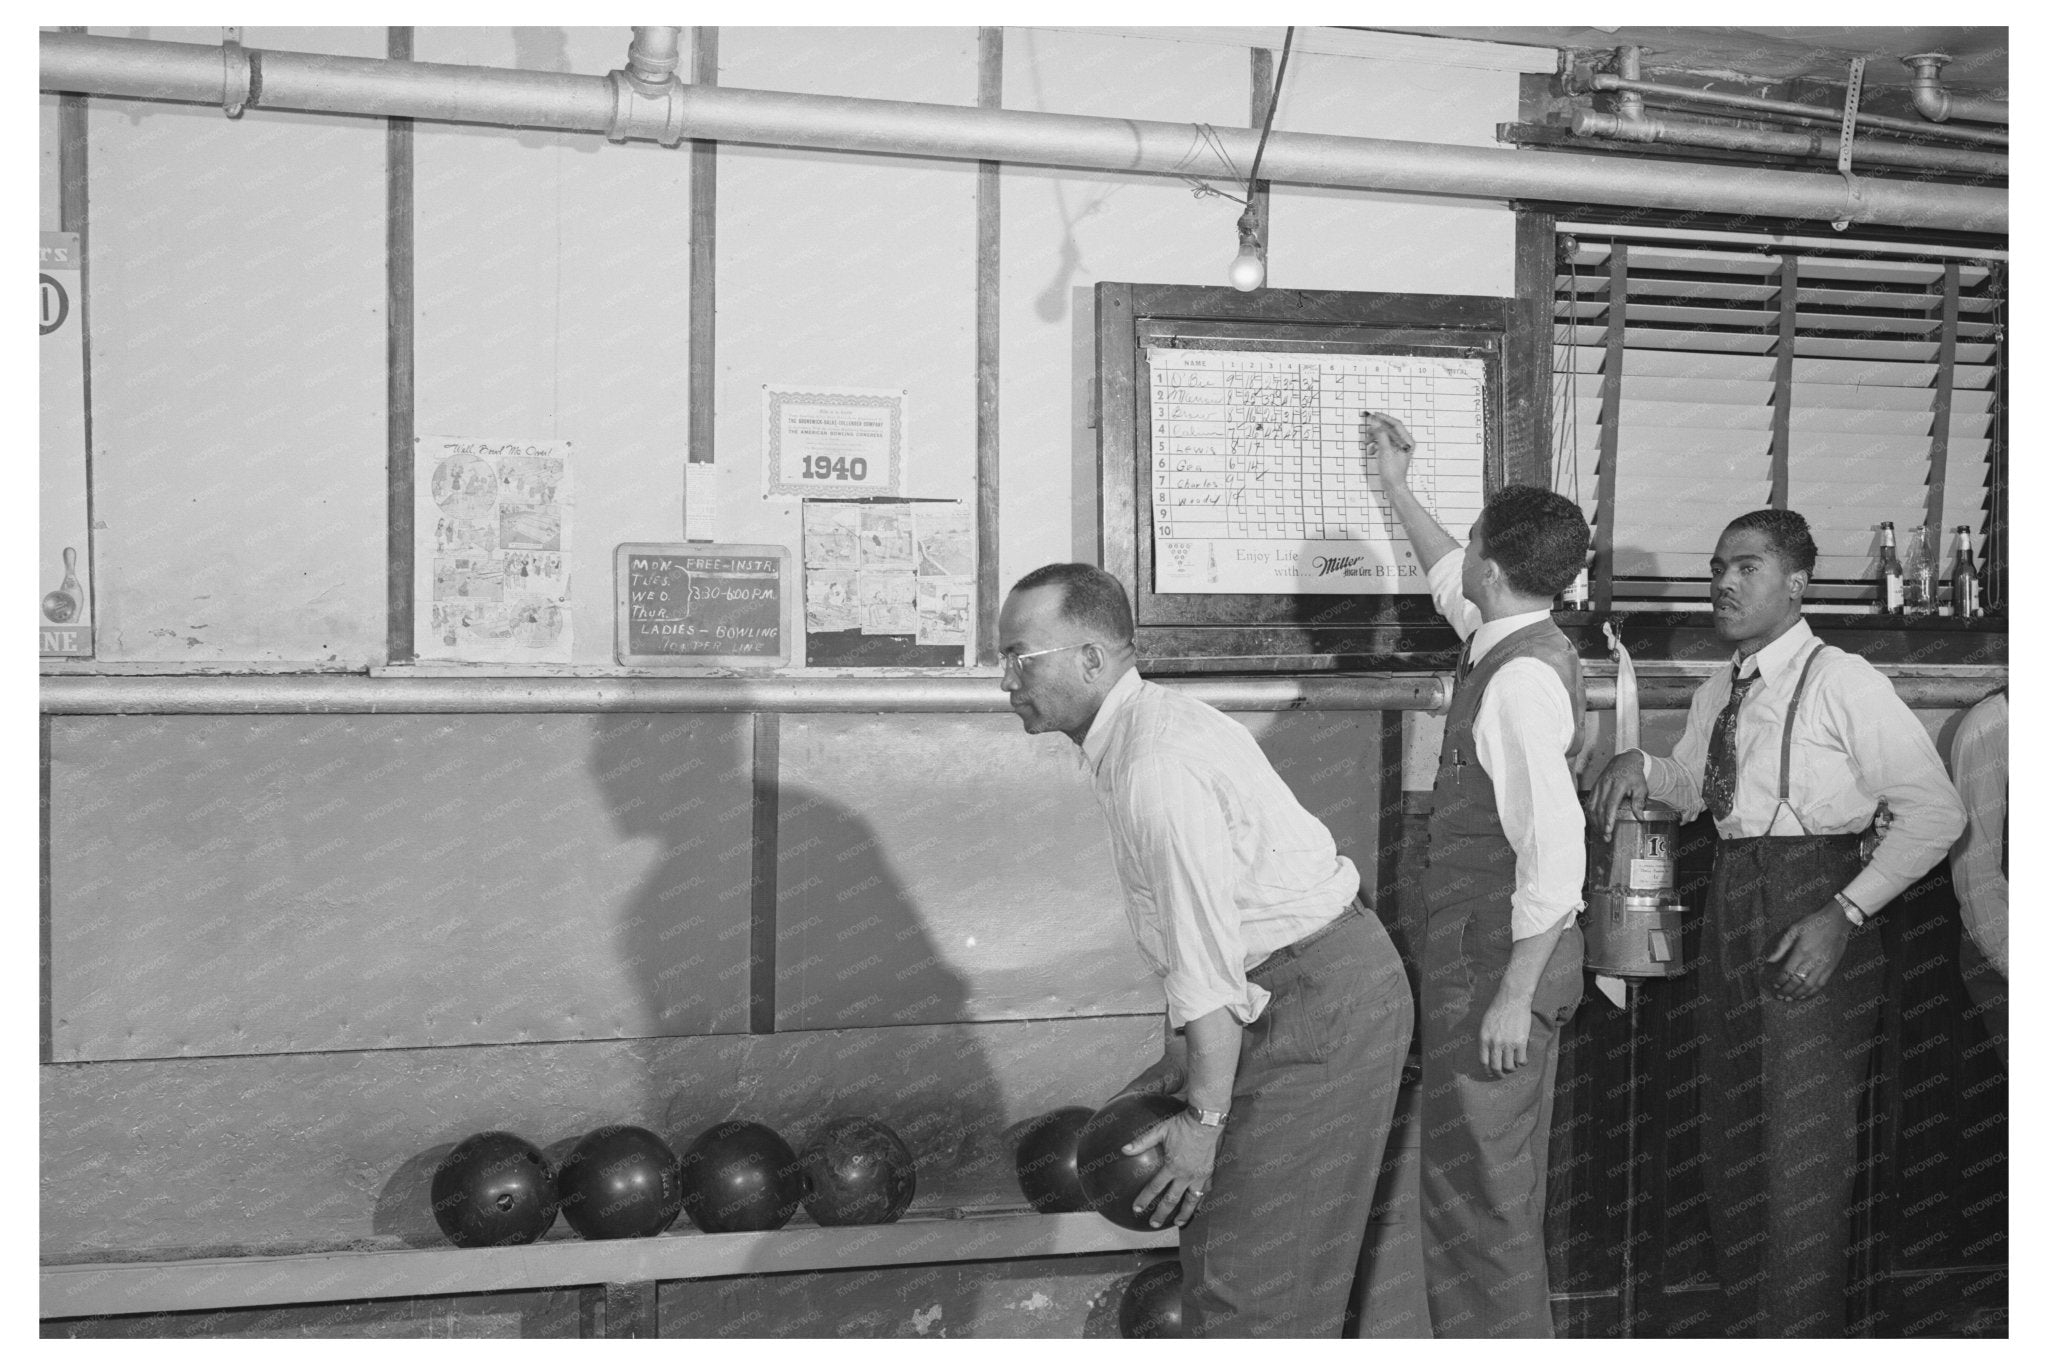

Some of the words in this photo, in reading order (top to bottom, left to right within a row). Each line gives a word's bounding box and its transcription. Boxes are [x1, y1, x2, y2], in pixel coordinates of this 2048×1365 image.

[1158, 374, 1162, 383] 1
[1158, 391, 1163, 400] 2
[1159, 408, 1164, 417] 3
[1158, 425, 1164, 433] 4
[1159, 442, 1164, 451] 5
[1159, 458, 1165, 467] 6
[802, 455, 867, 481] 1940
[1159, 476, 1165, 485] 7
[1160, 493, 1165, 502] 8
[1160, 509, 1166, 518] 9
[1159, 526, 1170, 535] 10
[1236, 549, 1271, 564] Enjoy
[1276, 549, 1298, 561] Life
[1312, 556, 1365, 577] Miller
[1375, 565, 1418, 577] BEER
[641, 624, 695, 635] LADIES
[716, 626, 778, 638] BOWLING
[732, 642, 764, 652] LINE
